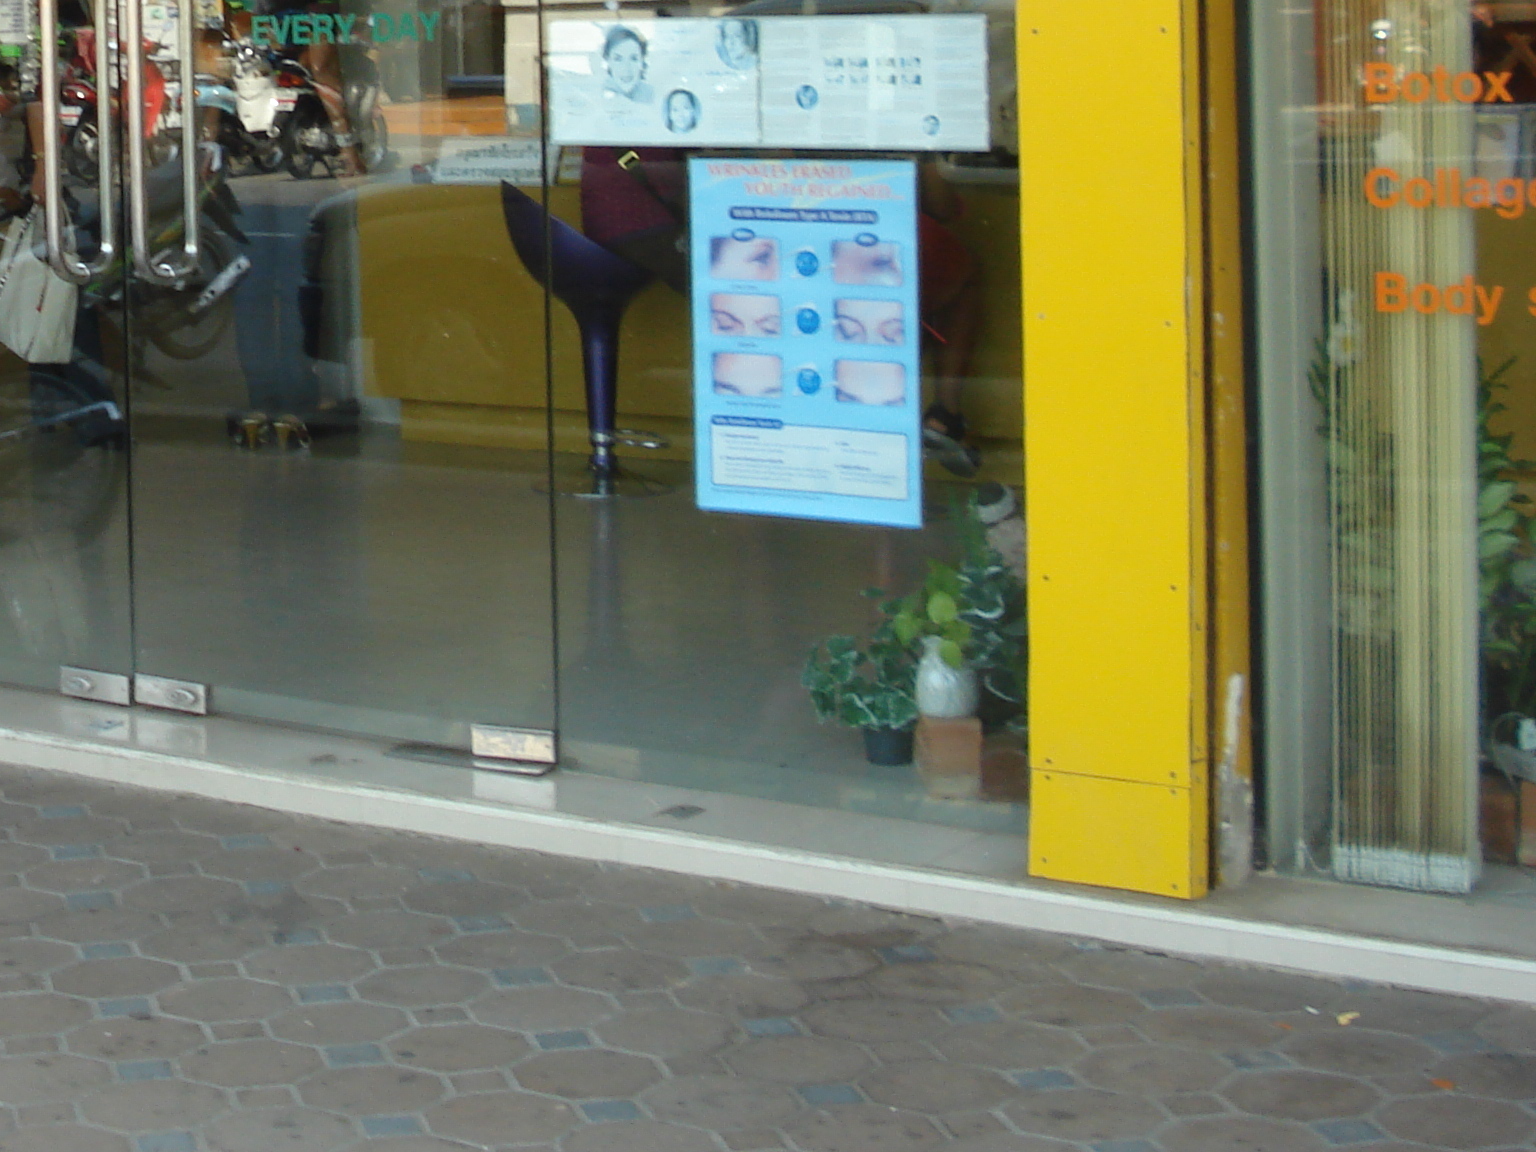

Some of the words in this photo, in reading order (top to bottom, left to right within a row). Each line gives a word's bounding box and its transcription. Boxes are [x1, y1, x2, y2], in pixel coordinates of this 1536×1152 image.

[251, 12, 357, 46] EVERY
[371, 11, 440, 43] DAY
[1364, 61, 1514, 103] Botox
[1375, 271, 1504, 325] Body
